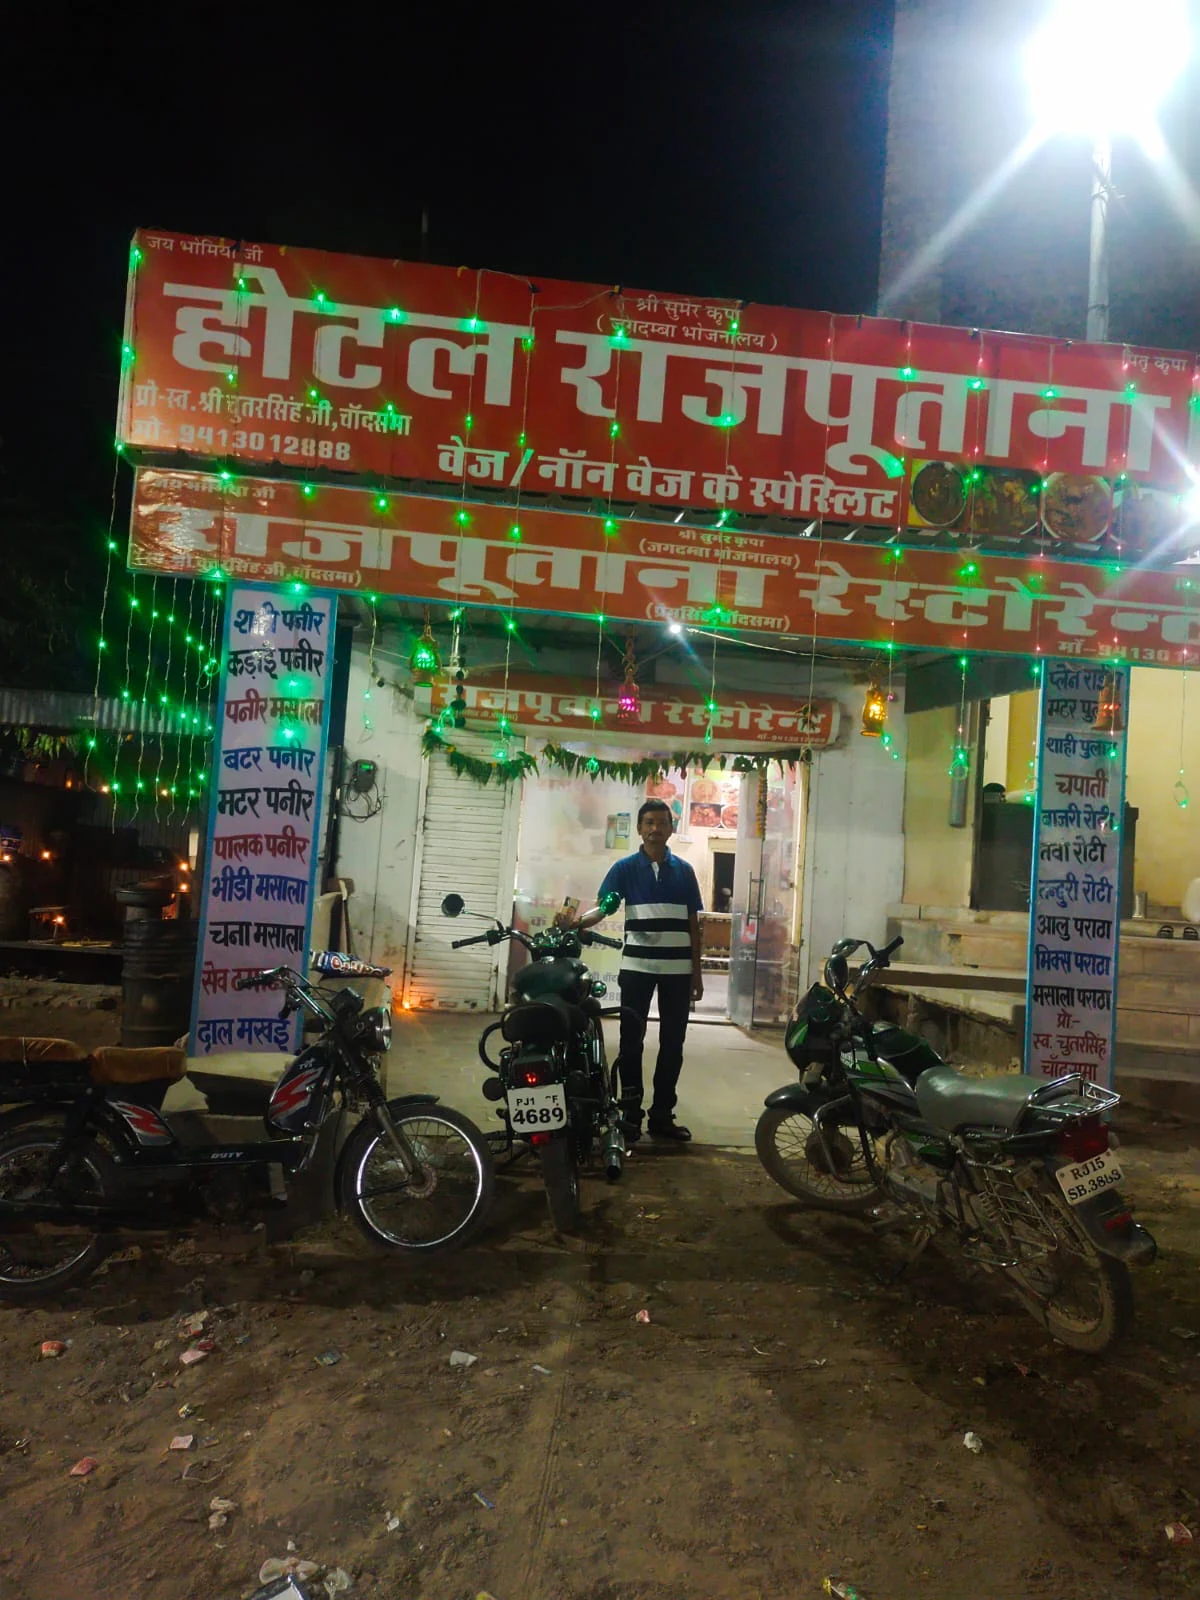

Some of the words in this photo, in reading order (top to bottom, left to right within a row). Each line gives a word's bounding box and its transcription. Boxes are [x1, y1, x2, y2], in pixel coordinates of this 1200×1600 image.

[146, 236, 175, 251] जय
[244, 244, 264, 262] जी
[636, 294, 659, 313] श्री
[664, 298, 702, 320] सुमेर
[706, 304, 743, 325] कृपा
[162, 263, 535, 406] होटल
[1153, 356, 1188, 376] कृपा
[555, 329, 1172, 480] राजपूताना
[625, 456, 695, 500] वेज
[701, 464, 743, 505] के
[678, 529, 697, 541] श्री
[150, 504, 780, 608] राजपूताना
[233, 601, 280, 634] शाी
[281, 602, 326, 636] पनीर
[278, 637, 324, 677] पनीर
[224, 688, 268, 724] पनीर
[1047, 698, 1077, 720] मटर
[222, 746, 263, 772] बटर
[265, 739, 316, 778] पनीर
[1046, 732, 1078, 758] शाही
[1054, 768, 1109, 798] चपाती
[217, 787, 262, 819] मटर
[262, 778, 315, 822] पनीर
[213, 833, 264, 862] पालक
[263, 824, 310, 865] पनीर
[1073, 835, 1107, 864] रोटी
[255, 873, 309, 905] मसाला
[1082, 874, 1113, 904] रोटी
[208, 921, 252, 948] चना
[253, 922, 306, 954] मसाला
[1036, 914, 1071, 941] आलु
[1072, 917, 1112, 941] पराठा
[1034, 944, 1072, 974] मिक्स
[1074, 951, 1112, 976] पराठा
[202, 960, 230, 996] सेव
[1032, 984, 1075, 1008] मसाला
[1076, 988, 1112, 1011] पराठा
[197, 1018, 236, 1053] दाल
[512, 1107, 564, 1125] 4689
[1070, 1157, 1105, 1180] RJ15
